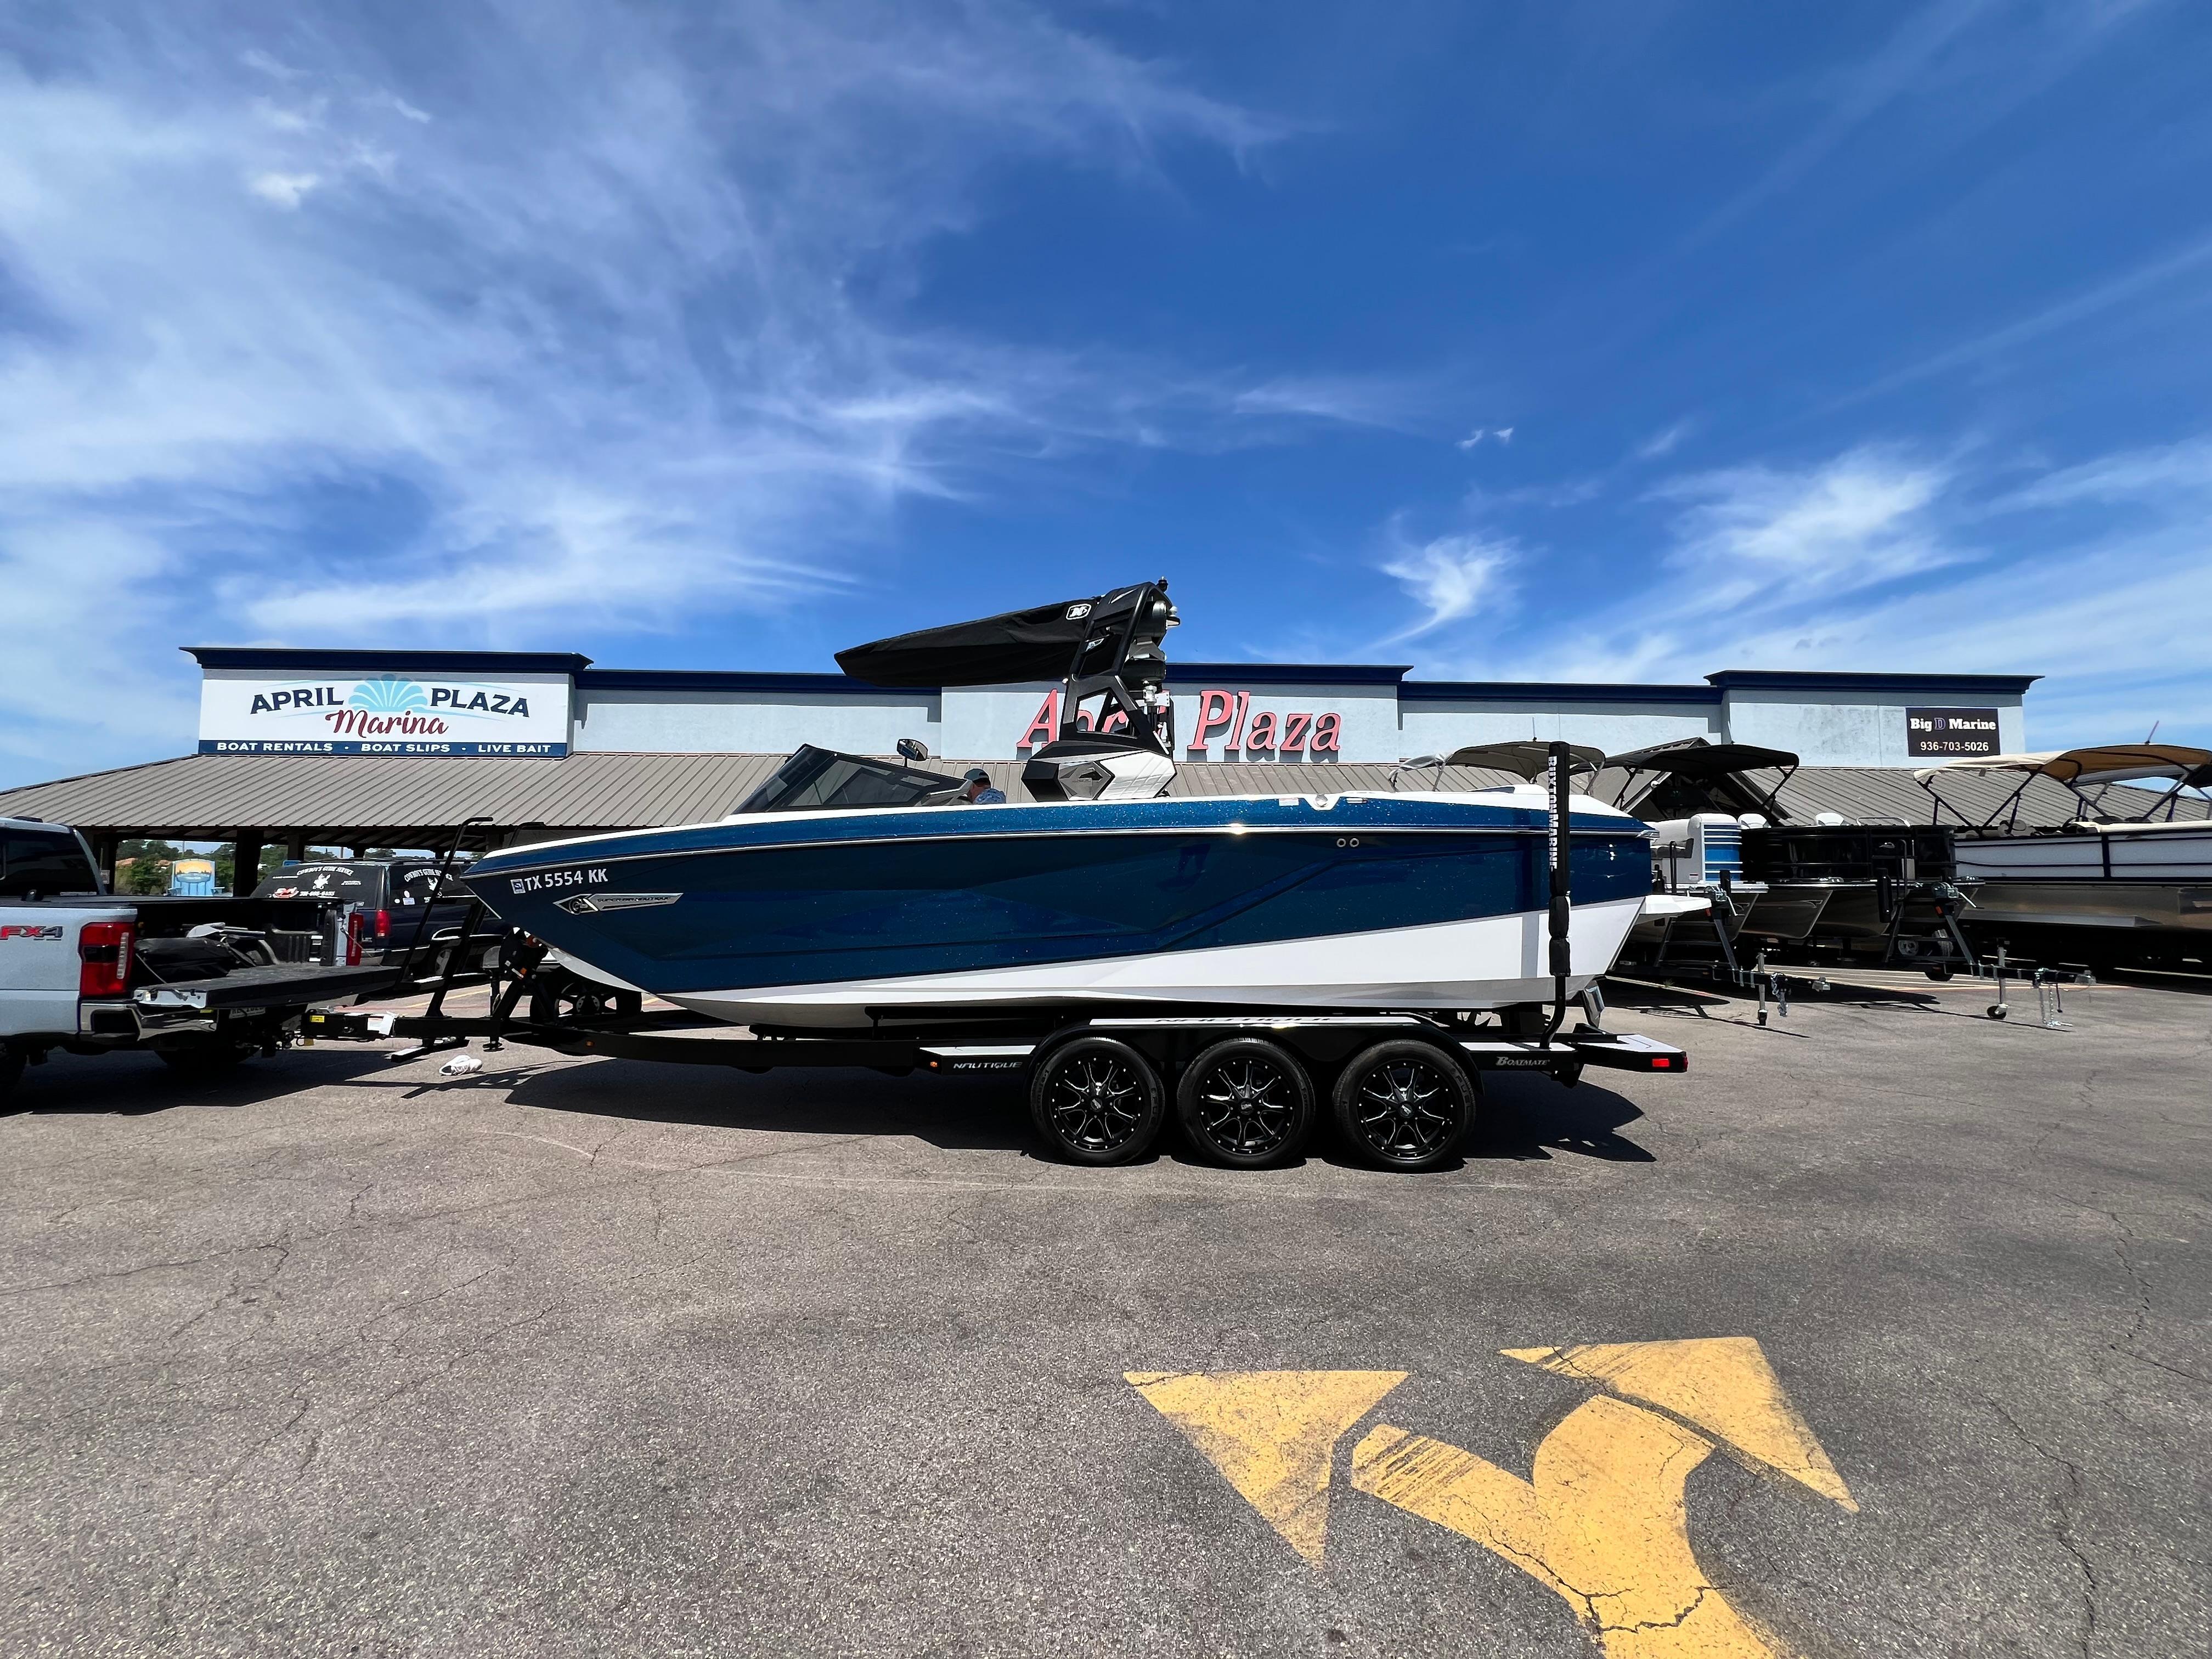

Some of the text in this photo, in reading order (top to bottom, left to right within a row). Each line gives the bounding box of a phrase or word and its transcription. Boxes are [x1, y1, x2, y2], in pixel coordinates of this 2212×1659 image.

[250, 687, 529, 718] APRIL PLAZA
[325, 709, 449, 738] Marina
[1187, 689, 1341, 751] Plaza
[1910, 717, 1996, 732] Big D Marine
[217, 742, 551, 753] BOAT RENTALS BOAT SLIPS LIVE BAIT
[1920, 741, 1989, 752] 936-703-5026
[524, 875, 542, 891] TX
[544, 870, 583, 888] 5554
[588, 868, 608, 883] KK
[0, 926, 63, 940] FX4
